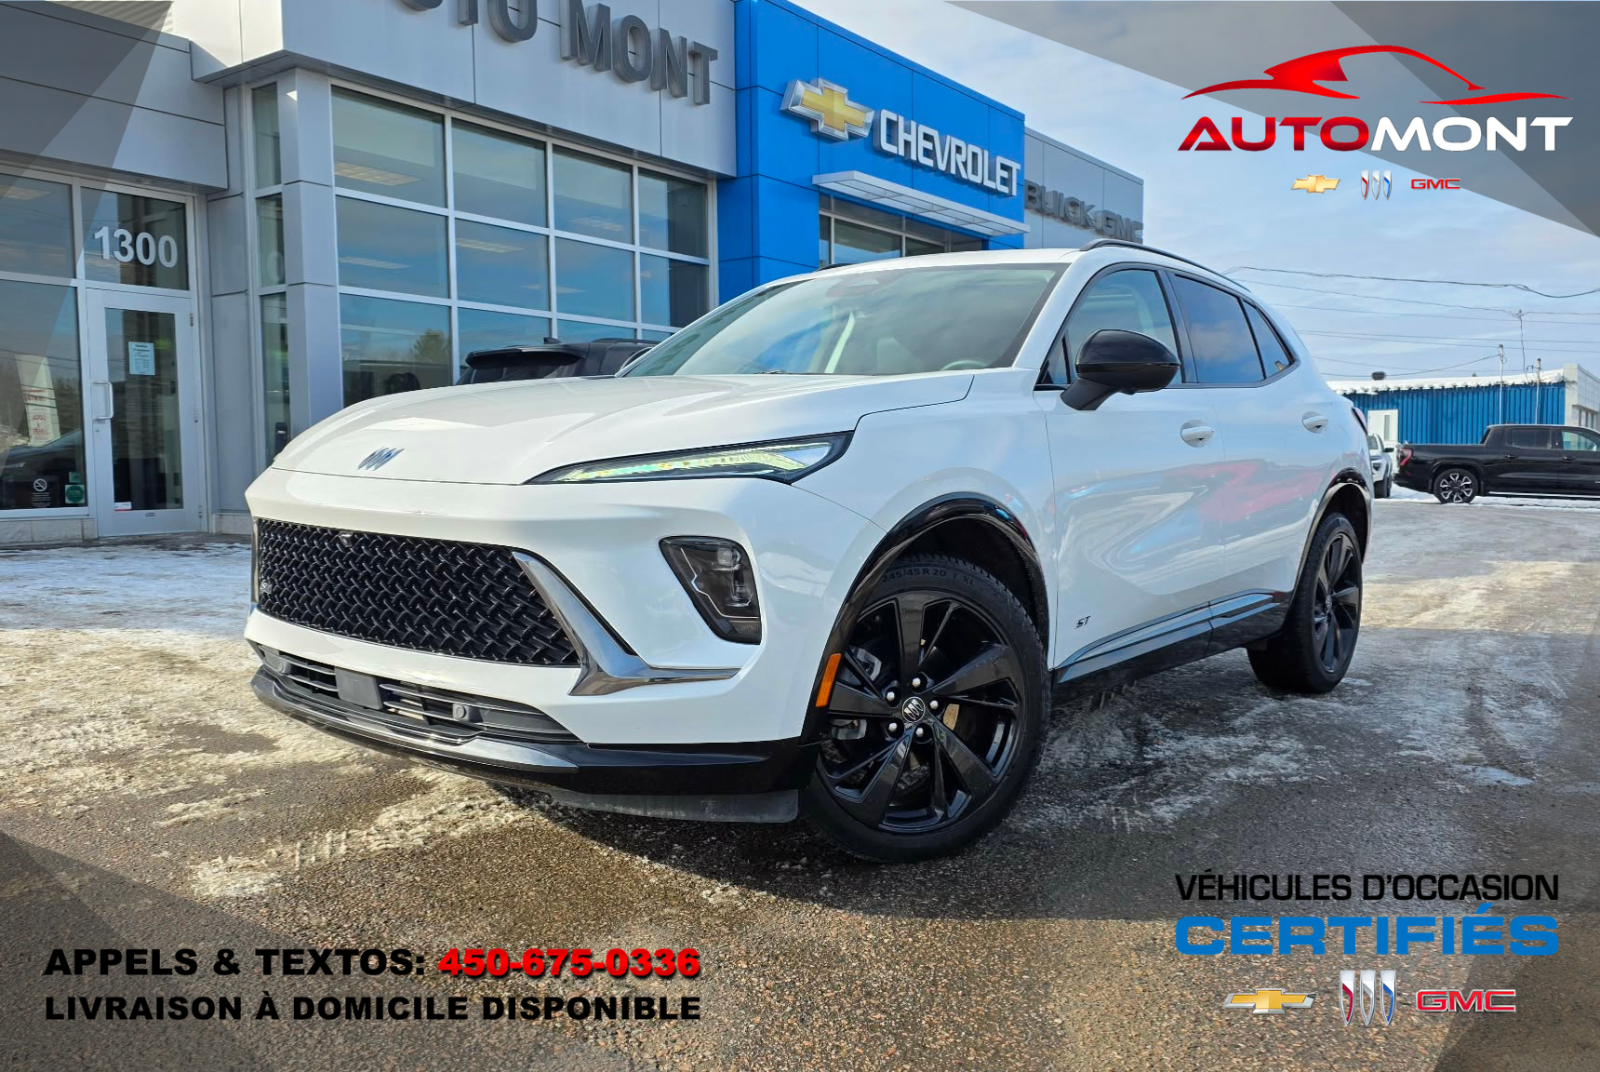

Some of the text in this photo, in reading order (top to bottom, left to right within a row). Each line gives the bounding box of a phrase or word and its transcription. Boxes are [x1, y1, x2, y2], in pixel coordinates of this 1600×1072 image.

[561, 0, 719, 105] MONT
[873, 109, 1022, 197] CHEVROLET
[94, 226, 178, 268] 1300
[1025, 179, 1143, 245] BUICK GMC
